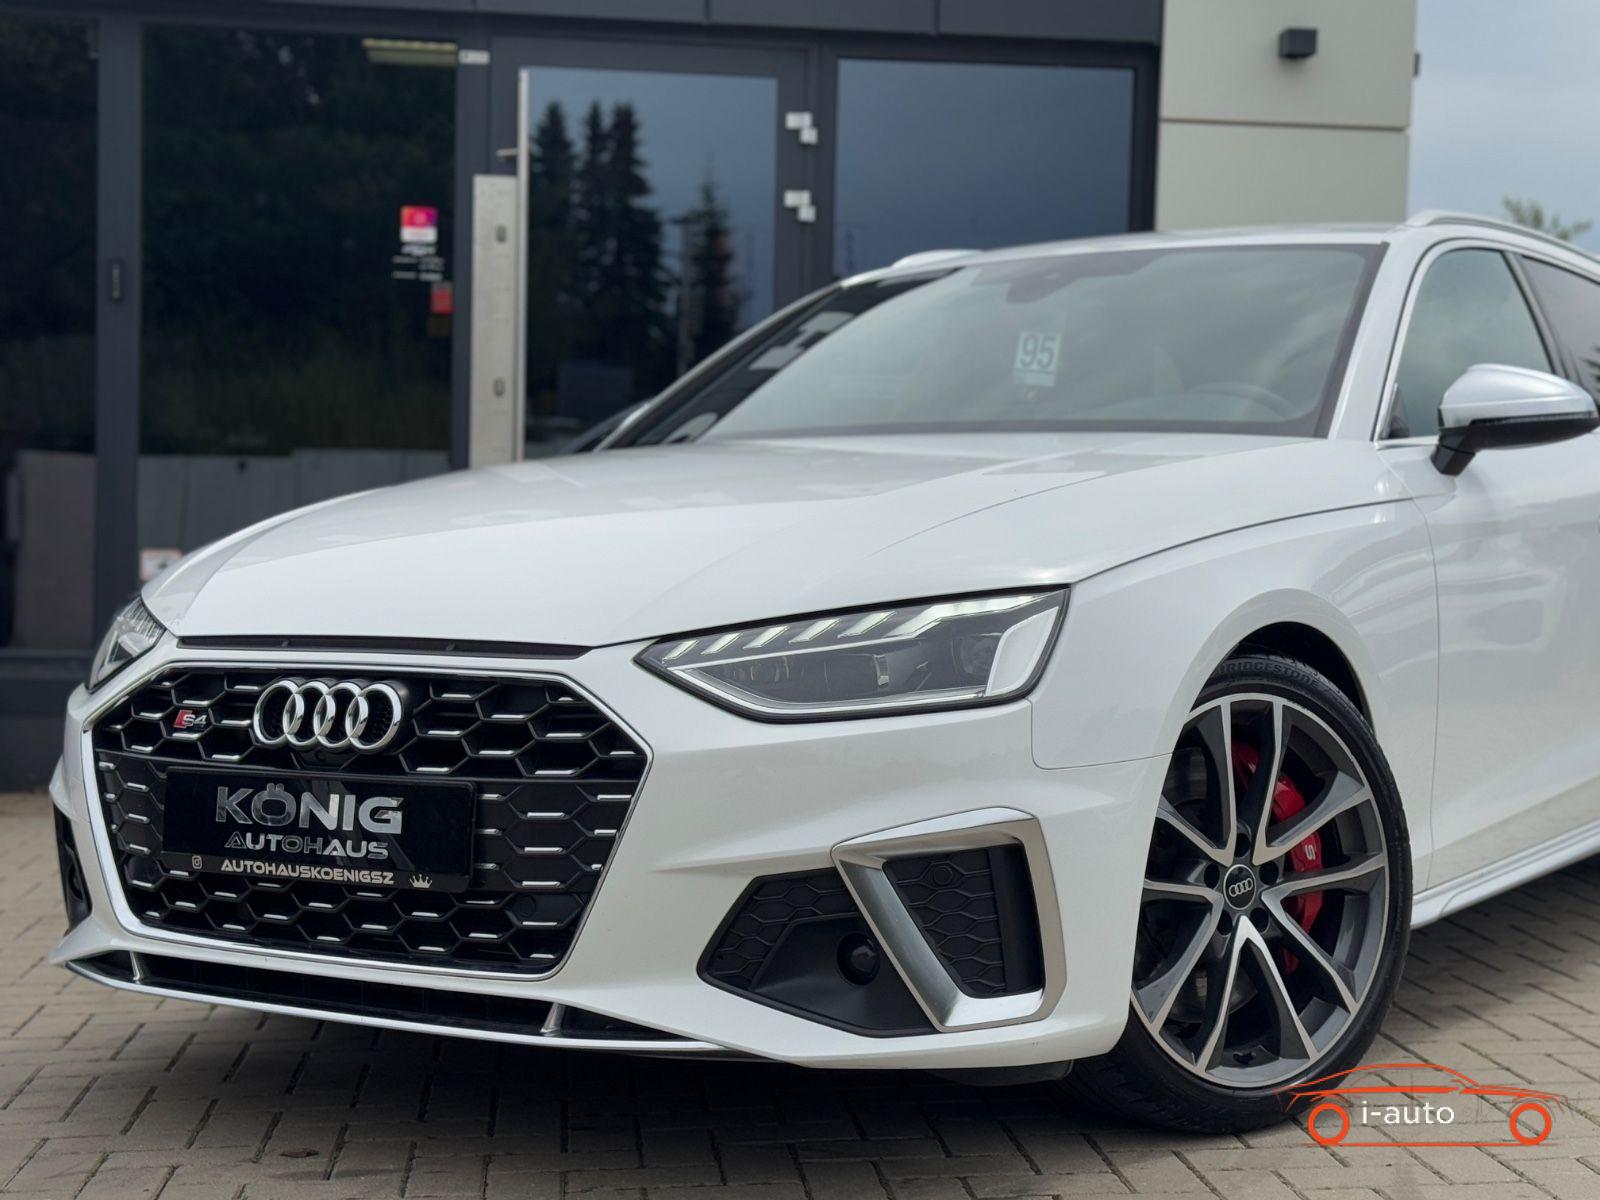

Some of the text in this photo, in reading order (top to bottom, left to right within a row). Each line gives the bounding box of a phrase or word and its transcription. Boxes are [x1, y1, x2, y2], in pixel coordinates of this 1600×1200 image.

[1020, 334, 1056, 369] 95
[181, 712, 207, 727] S4
[215, 782, 404, 835] KÖNIG
[224, 831, 389, 860] AUTOHAUS
[221, 859, 395, 885] AUTOHAUSKOENIGSZ
